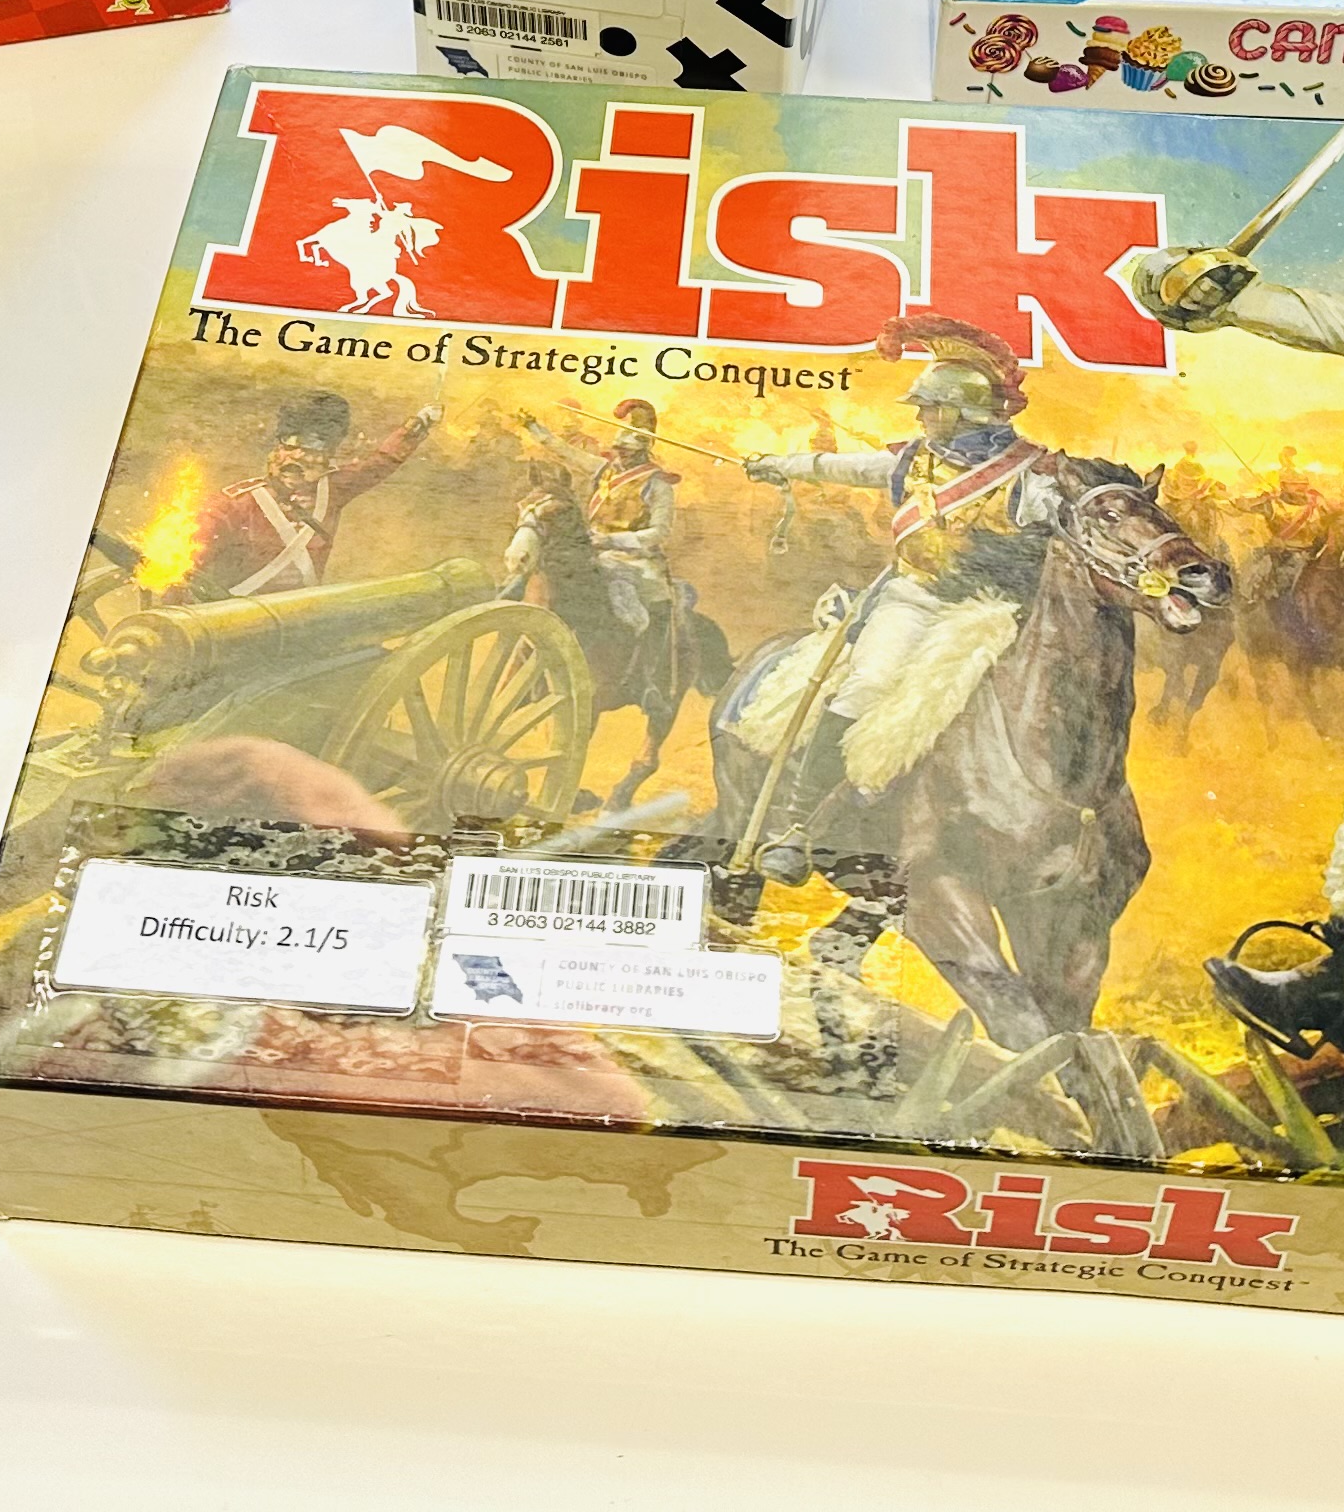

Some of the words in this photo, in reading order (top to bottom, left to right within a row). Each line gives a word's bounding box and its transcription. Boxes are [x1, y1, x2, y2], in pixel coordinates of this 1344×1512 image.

[202, 81, 1178, 375] Risk
[187, 307, 262, 350] The
[277, 319, 392, 362] Game
[406, 326, 453, 366] of
[458, 334, 638, 383] Strategic
[654, 346, 851, 394] Conquest
[226, 885, 279, 908] Risk
[140, 916, 269, 949] Difficulty:
[277, 926, 349, 953] 2.1/5
[487, 913, 498, 926] 3
[503, 914, 548, 929] 2063
[553, 917, 607, 932] 02144
[613, 920, 655, 935] 3882
[789, 1157, 1299, 1271] Risk
[764, 1238, 824, 1259] The
[836, 1243, 929, 1267] Game
[938, 1249, 975, 1268] of
[983, 1253, 1125, 1280] Strategic
[1136, 1263, 1294, 1292] Conquest
